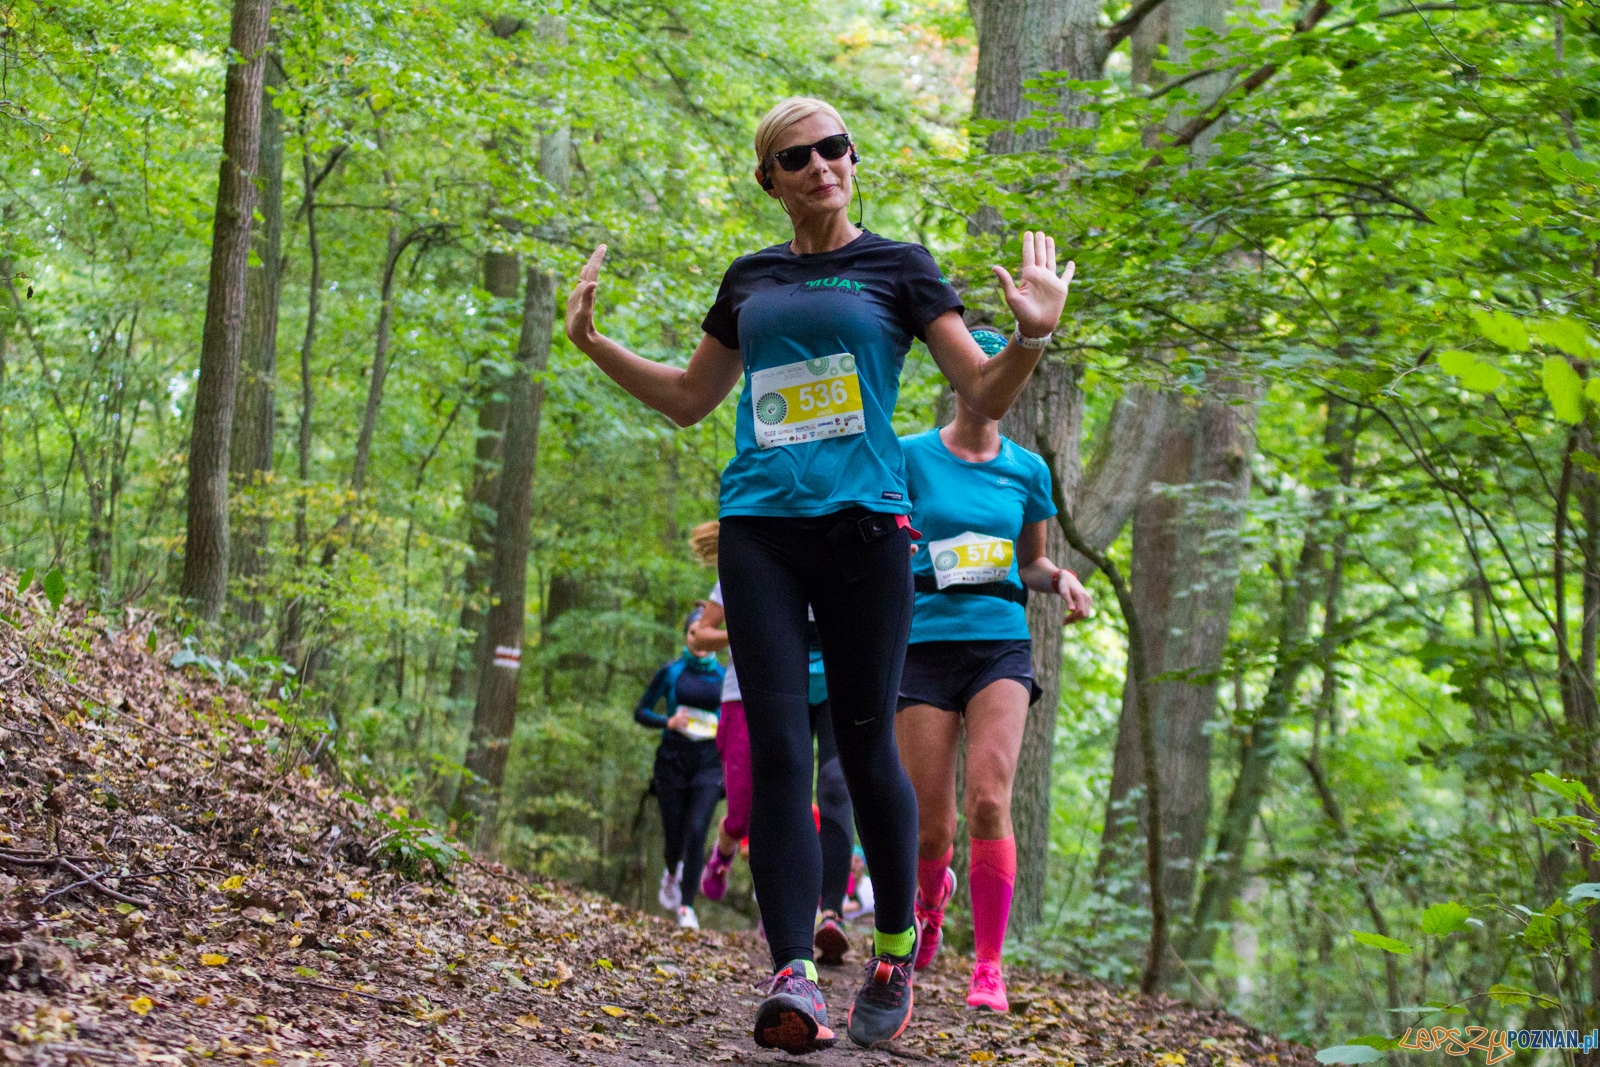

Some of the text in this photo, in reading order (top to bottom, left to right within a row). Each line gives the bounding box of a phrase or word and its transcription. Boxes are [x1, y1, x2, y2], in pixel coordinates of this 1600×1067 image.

[805, 277, 867, 292] MUAY
[799, 380, 848, 411] 536
[967, 543, 1005, 562] 574
